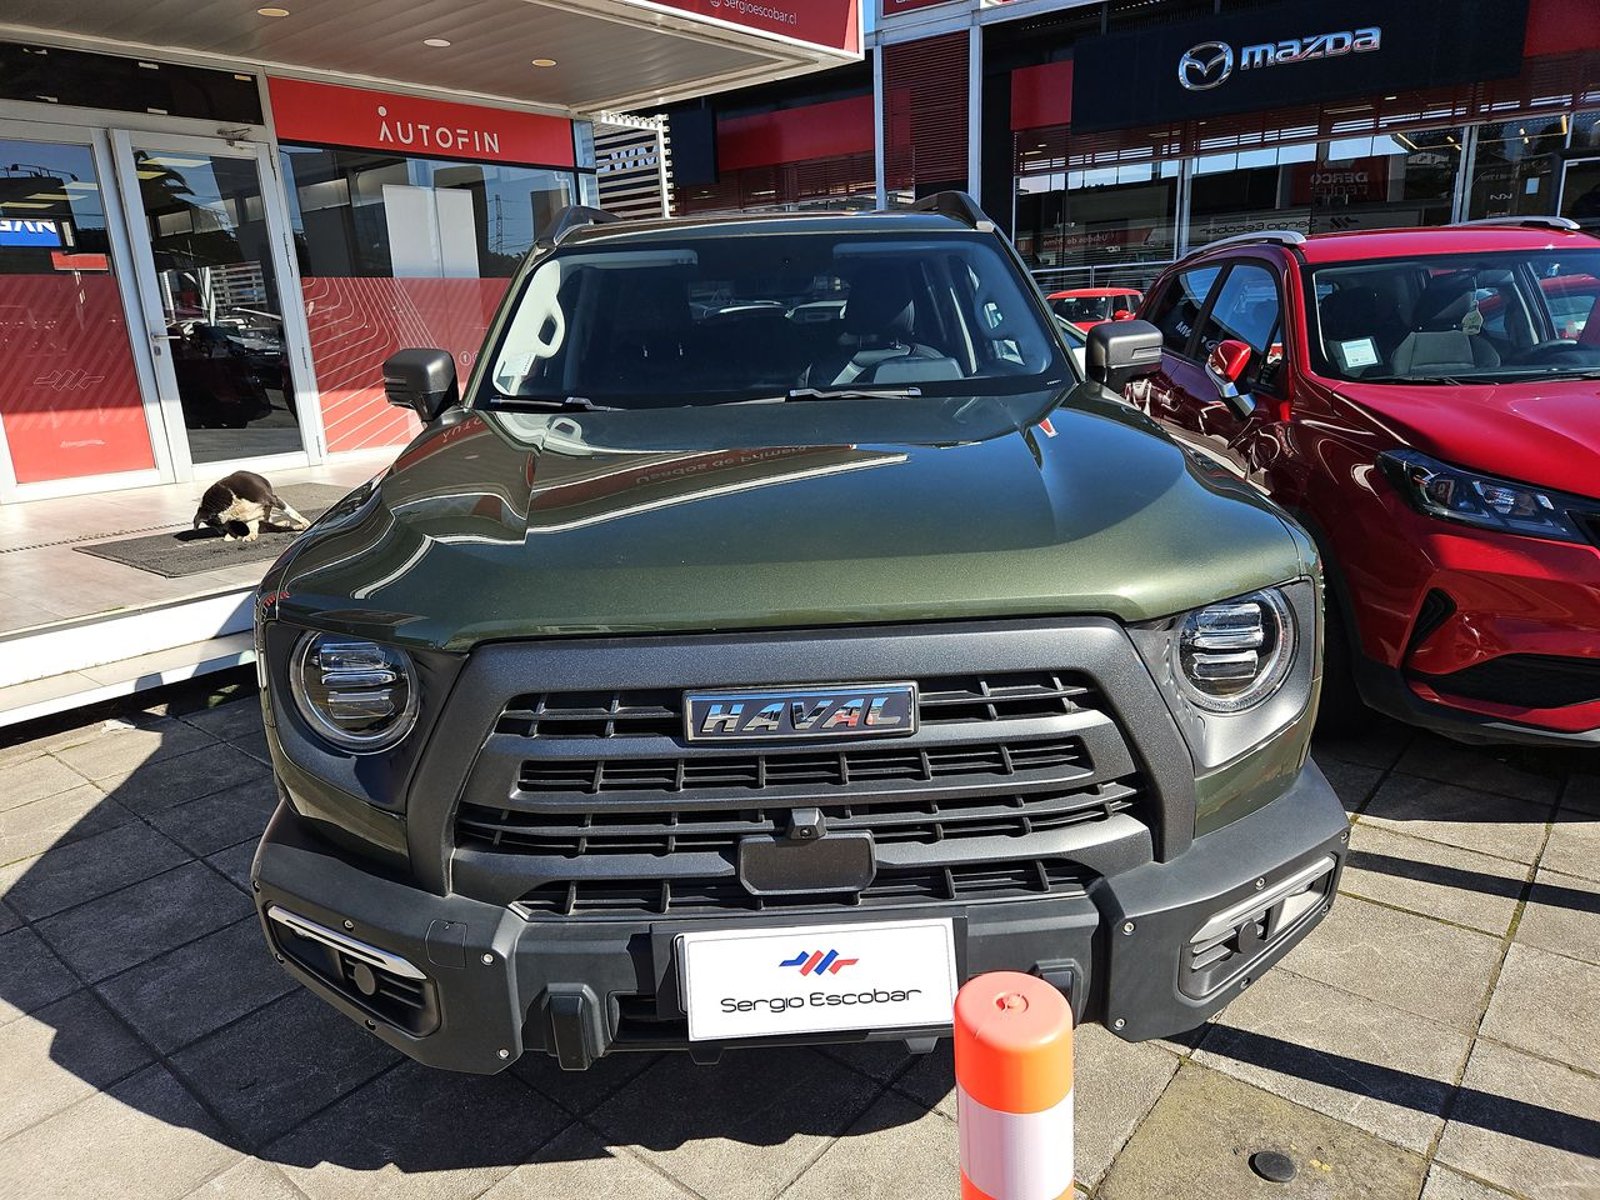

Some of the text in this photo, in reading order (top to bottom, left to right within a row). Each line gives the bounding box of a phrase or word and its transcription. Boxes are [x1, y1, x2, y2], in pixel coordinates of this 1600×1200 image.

[378, 106, 500, 154] AUTOFIN
[701, 697, 900, 732] HAVAL
[720, 988, 922, 1013] Sergio Escobar
